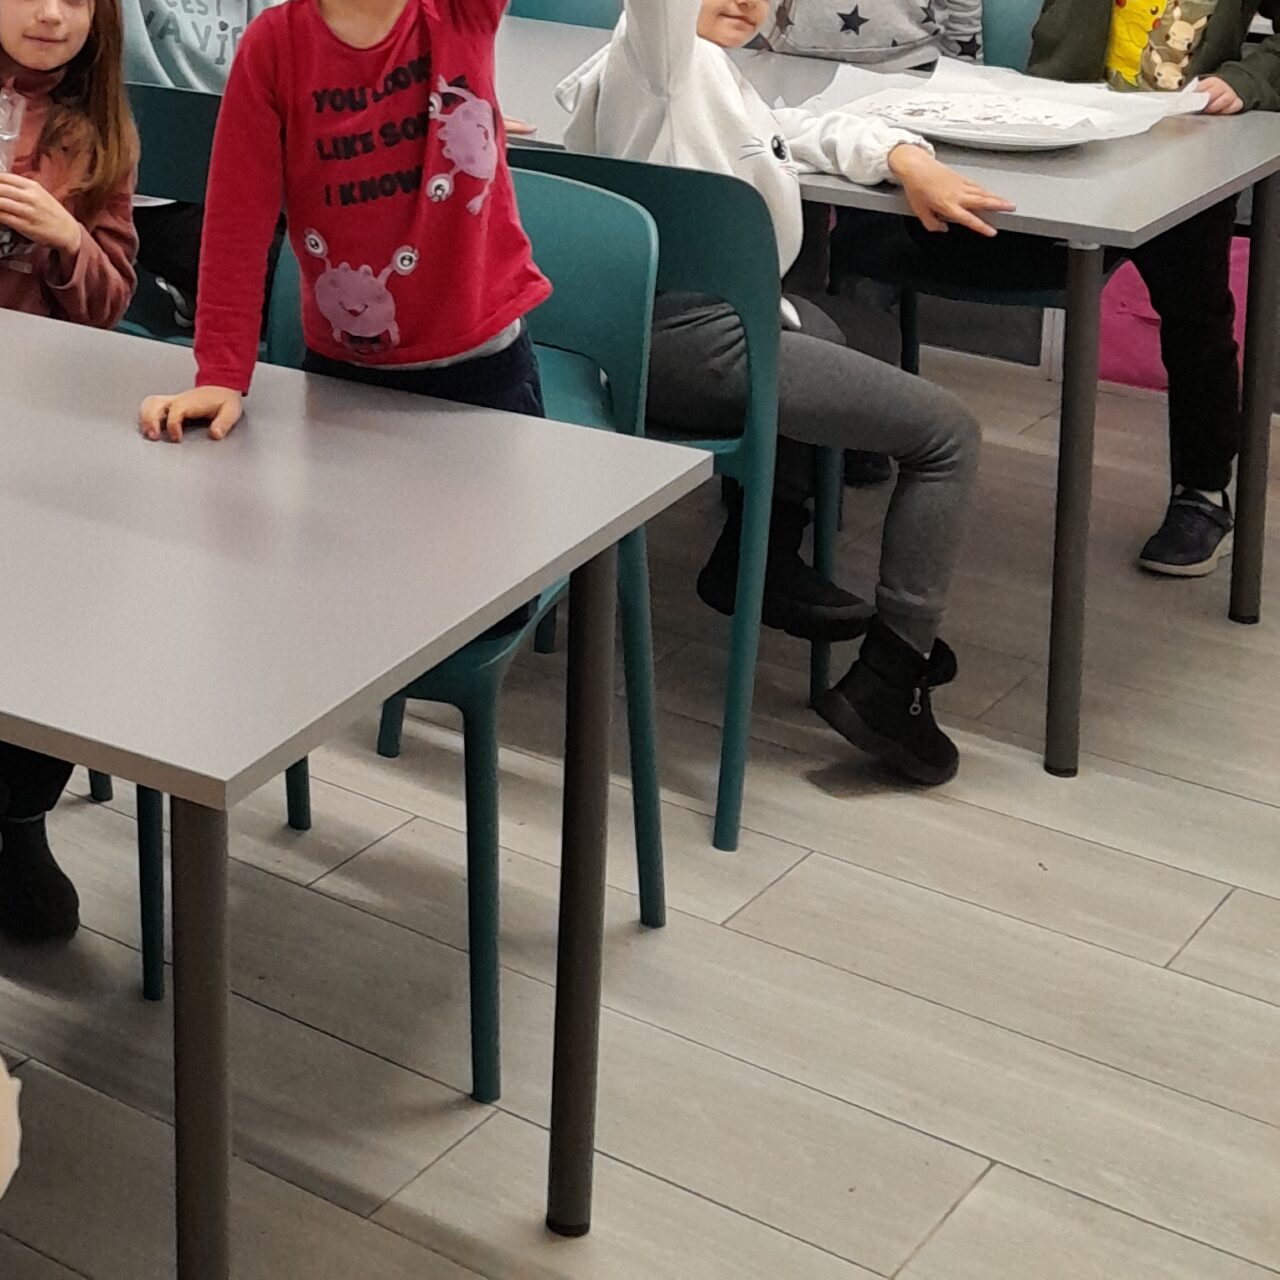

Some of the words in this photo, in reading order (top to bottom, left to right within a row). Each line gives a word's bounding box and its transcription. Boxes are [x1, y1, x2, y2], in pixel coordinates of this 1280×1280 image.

[145, 10, 181, 43] A
[312, 87, 368, 113] YOU
[316, 130, 375, 160] LIKE
[324, 184, 332, 207] I
[339, 165, 422, 206] KNOW
